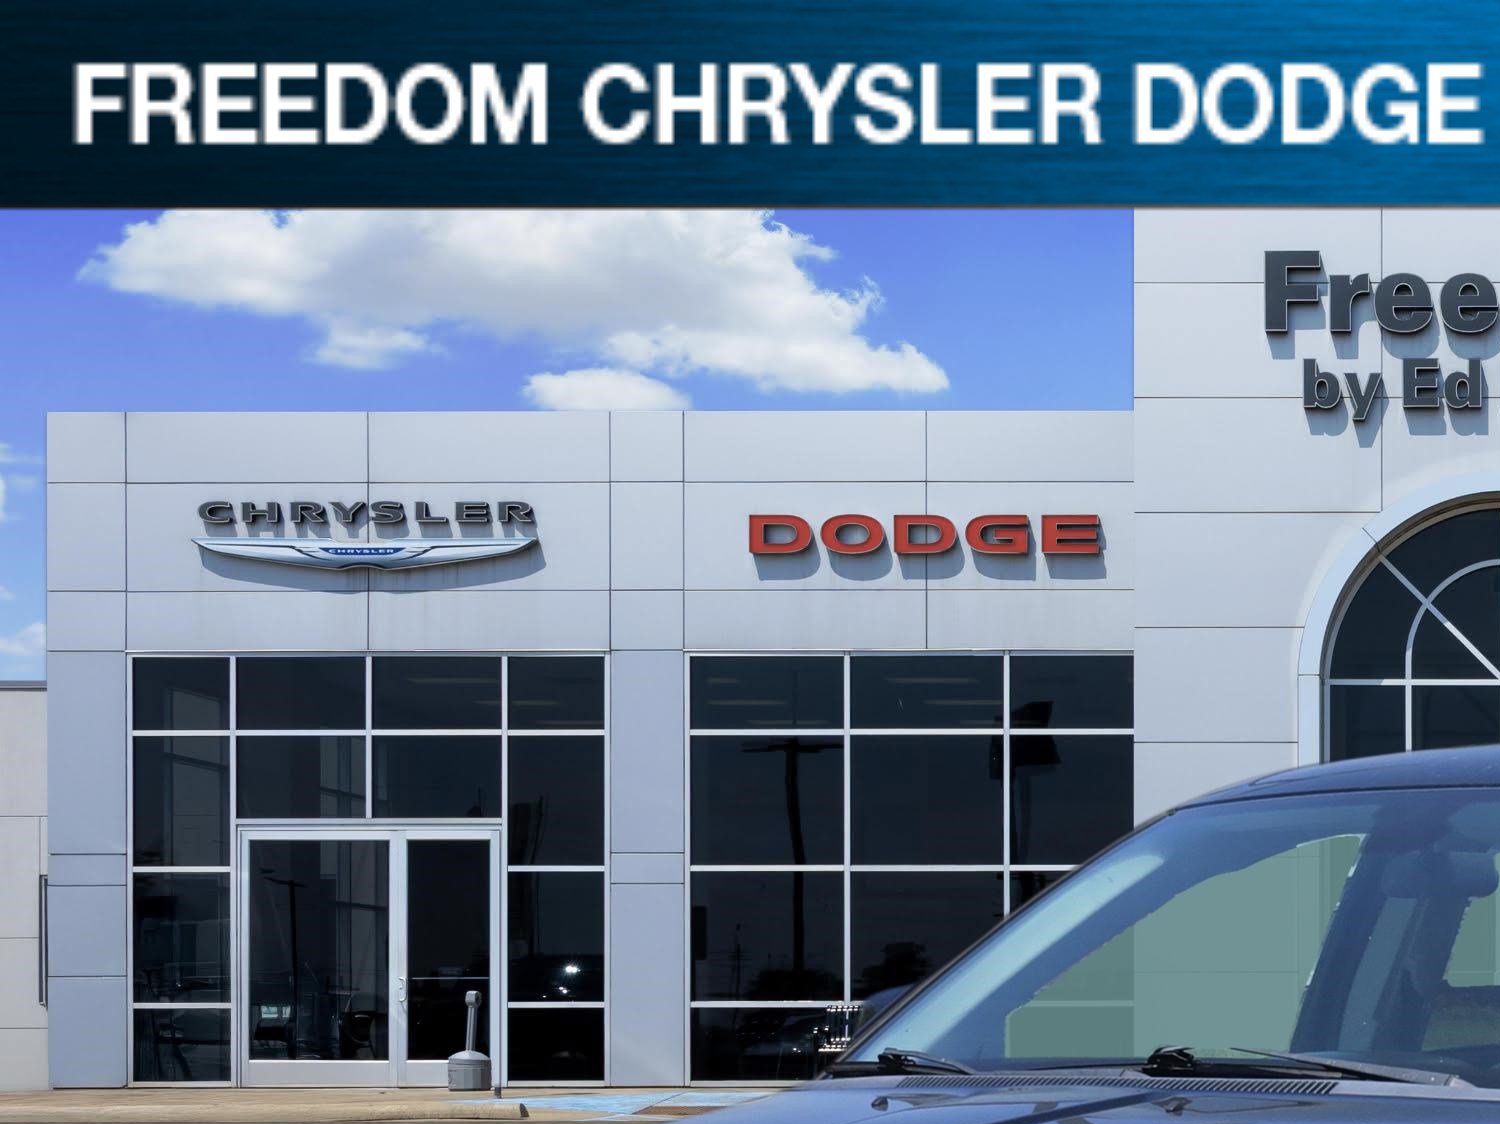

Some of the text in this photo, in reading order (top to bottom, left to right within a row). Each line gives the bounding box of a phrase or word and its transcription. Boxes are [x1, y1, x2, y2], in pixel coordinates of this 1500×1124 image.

[1303, 358, 1382, 421] by
[1402, 358, 1482, 410] Ed
[197, 501, 534, 524] CHRYSLER
[748, 514, 1101, 554] DODGE
